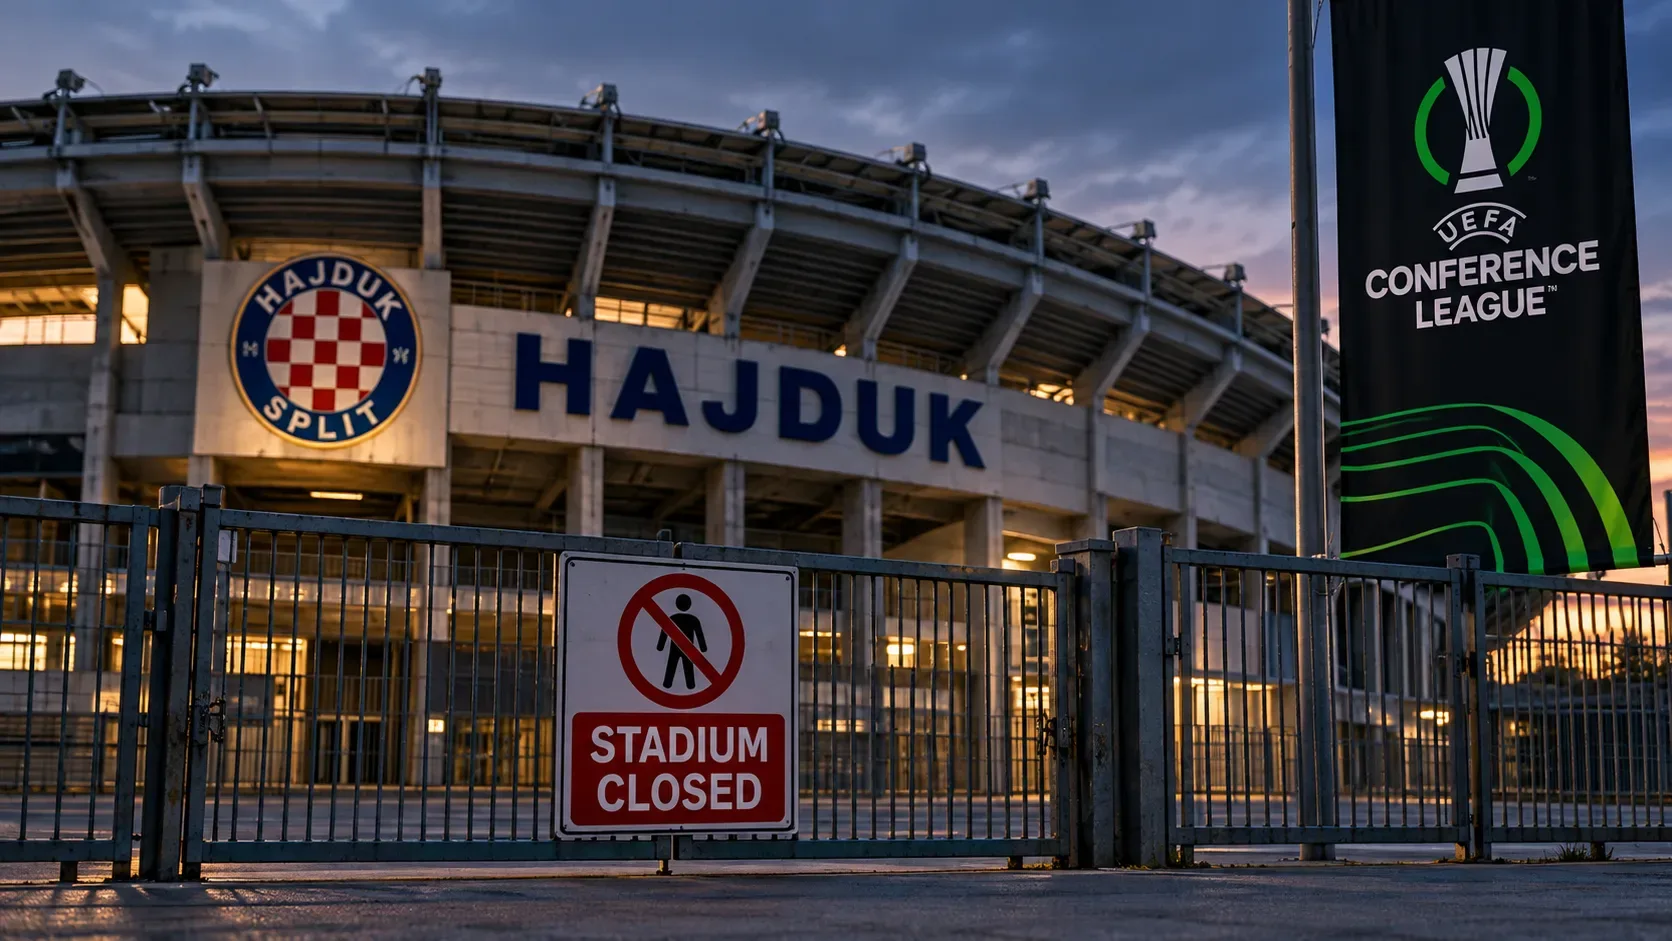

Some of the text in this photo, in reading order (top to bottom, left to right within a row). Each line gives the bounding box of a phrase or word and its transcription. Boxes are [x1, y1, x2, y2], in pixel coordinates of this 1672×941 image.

[1438, 209, 1516, 244] UEFA
[255, 260, 403, 322] HAJDUK
[1365, 239, 1600, 299] CONFERENCE
[263, 395, 379, 440] SPLIT
[515, 332, 986, 469] HAJDUK
[590, 725, 768, 763] STADIUM
[597, 772, 762, 812] CLOSED
